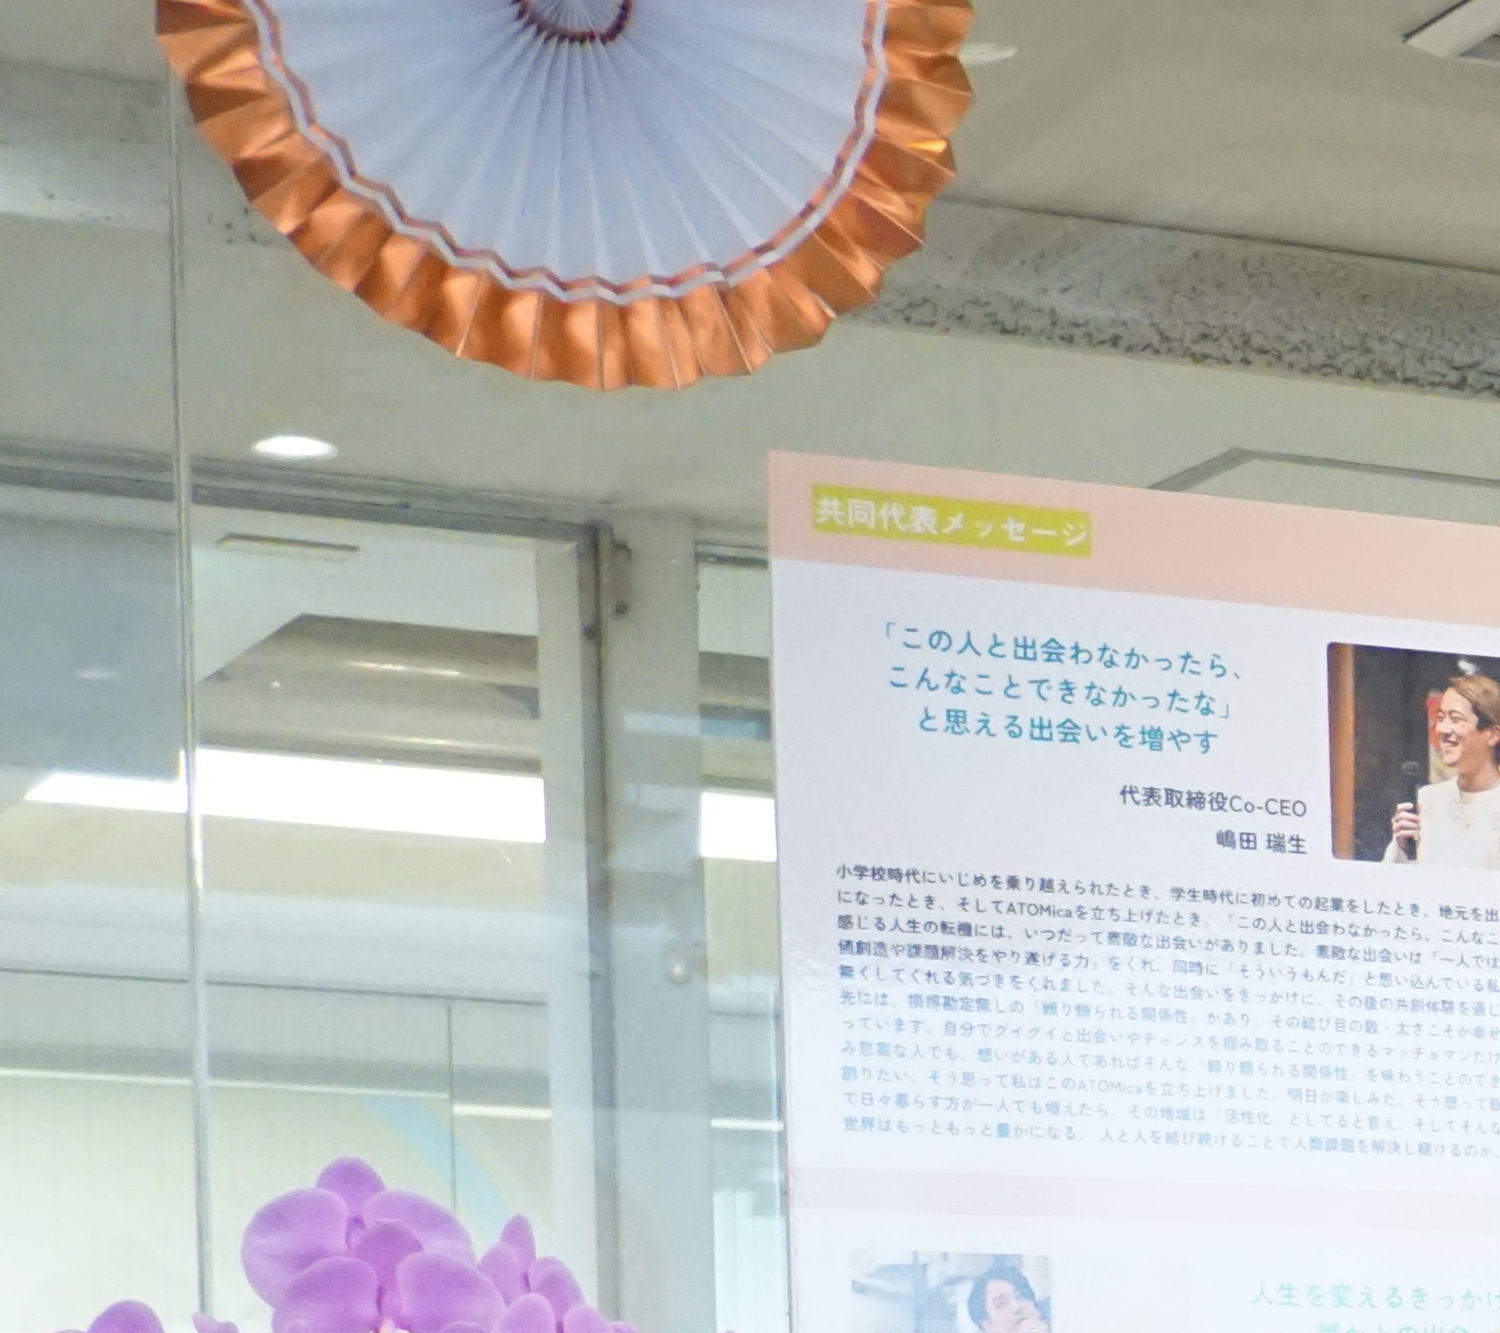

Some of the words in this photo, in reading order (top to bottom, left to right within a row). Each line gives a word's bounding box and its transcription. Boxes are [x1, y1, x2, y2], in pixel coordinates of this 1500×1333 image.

[815, 494, 1088, 552] 共同代表メッセージ
[884, 621, 1242, 683] 「この人と出会わなかったら、
[887, 661, 1236, 721] こんなことできなかったな」
[916, 704, 1220, 759] と思える出会いを増やす
[1119, 782, 1307, 821] 代表取締役Co-CEO
